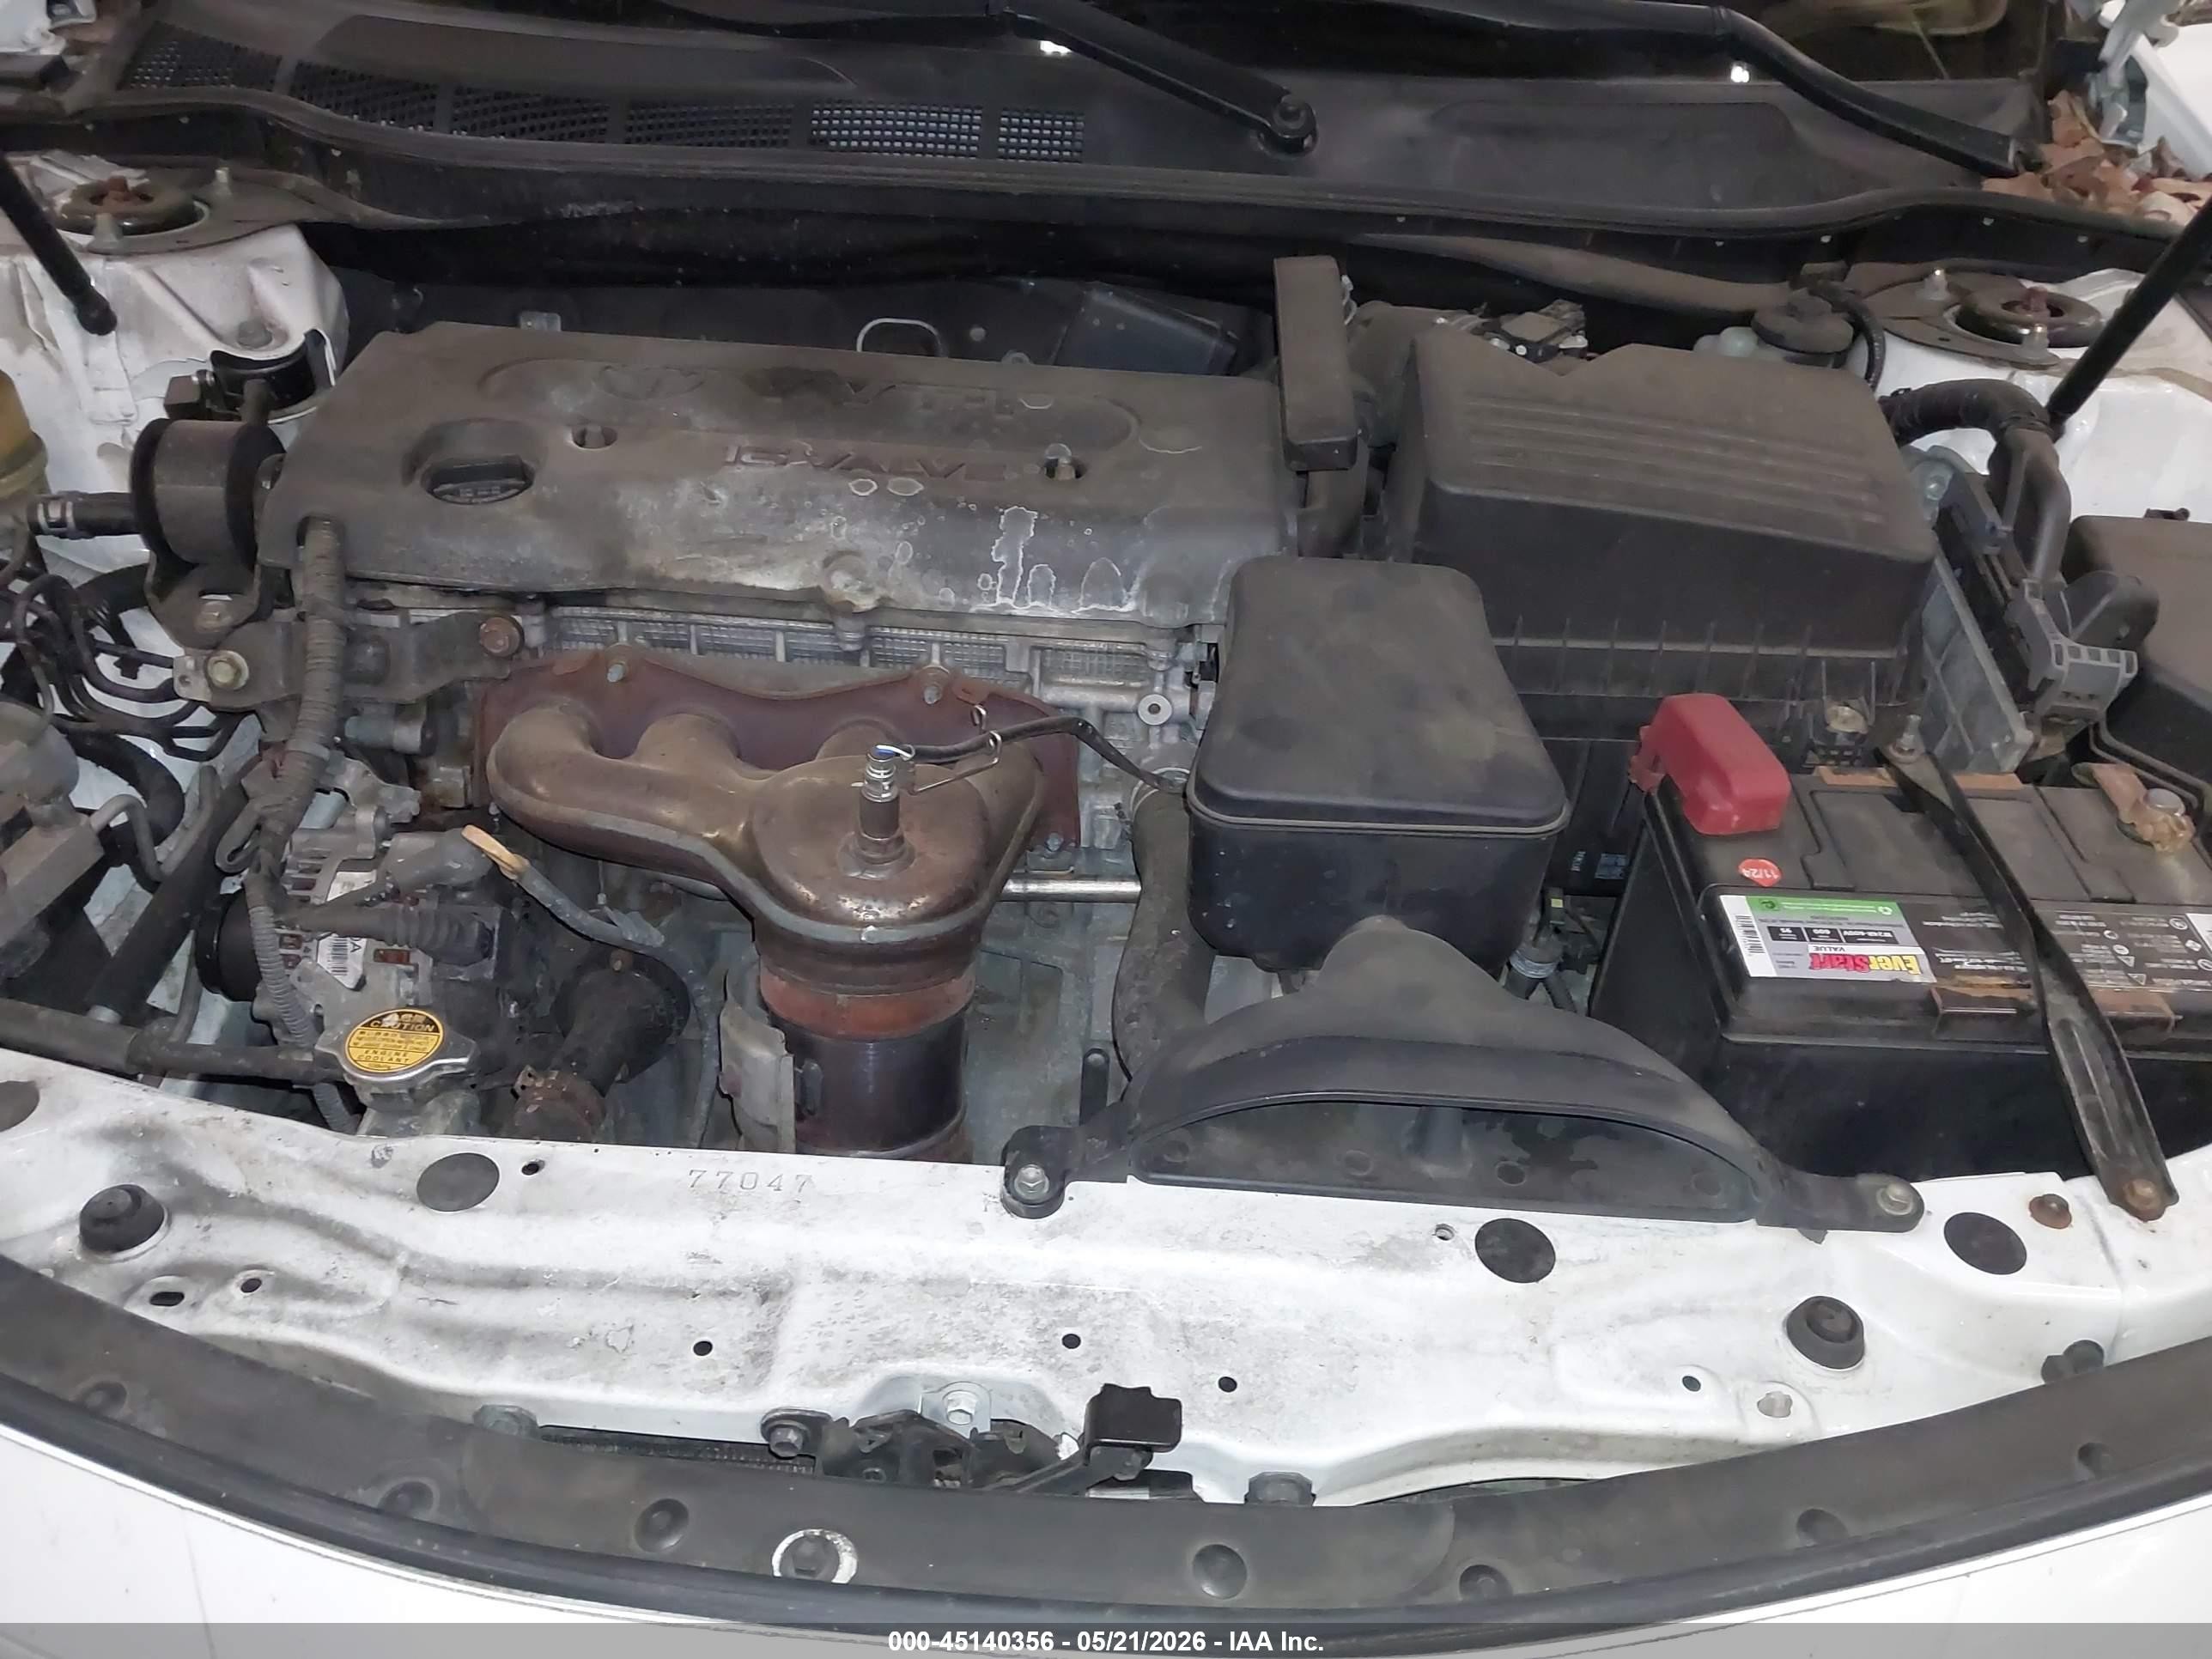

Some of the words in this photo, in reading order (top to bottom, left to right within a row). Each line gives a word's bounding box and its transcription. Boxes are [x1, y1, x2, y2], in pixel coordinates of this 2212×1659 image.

[1809, 952, 1923, 975] EverStart
[356, 1054, 410, 1064] COOLANT
[364, 1048, 410, 1058] ENGINE
[688, 1169, 814, 1194] 77047
